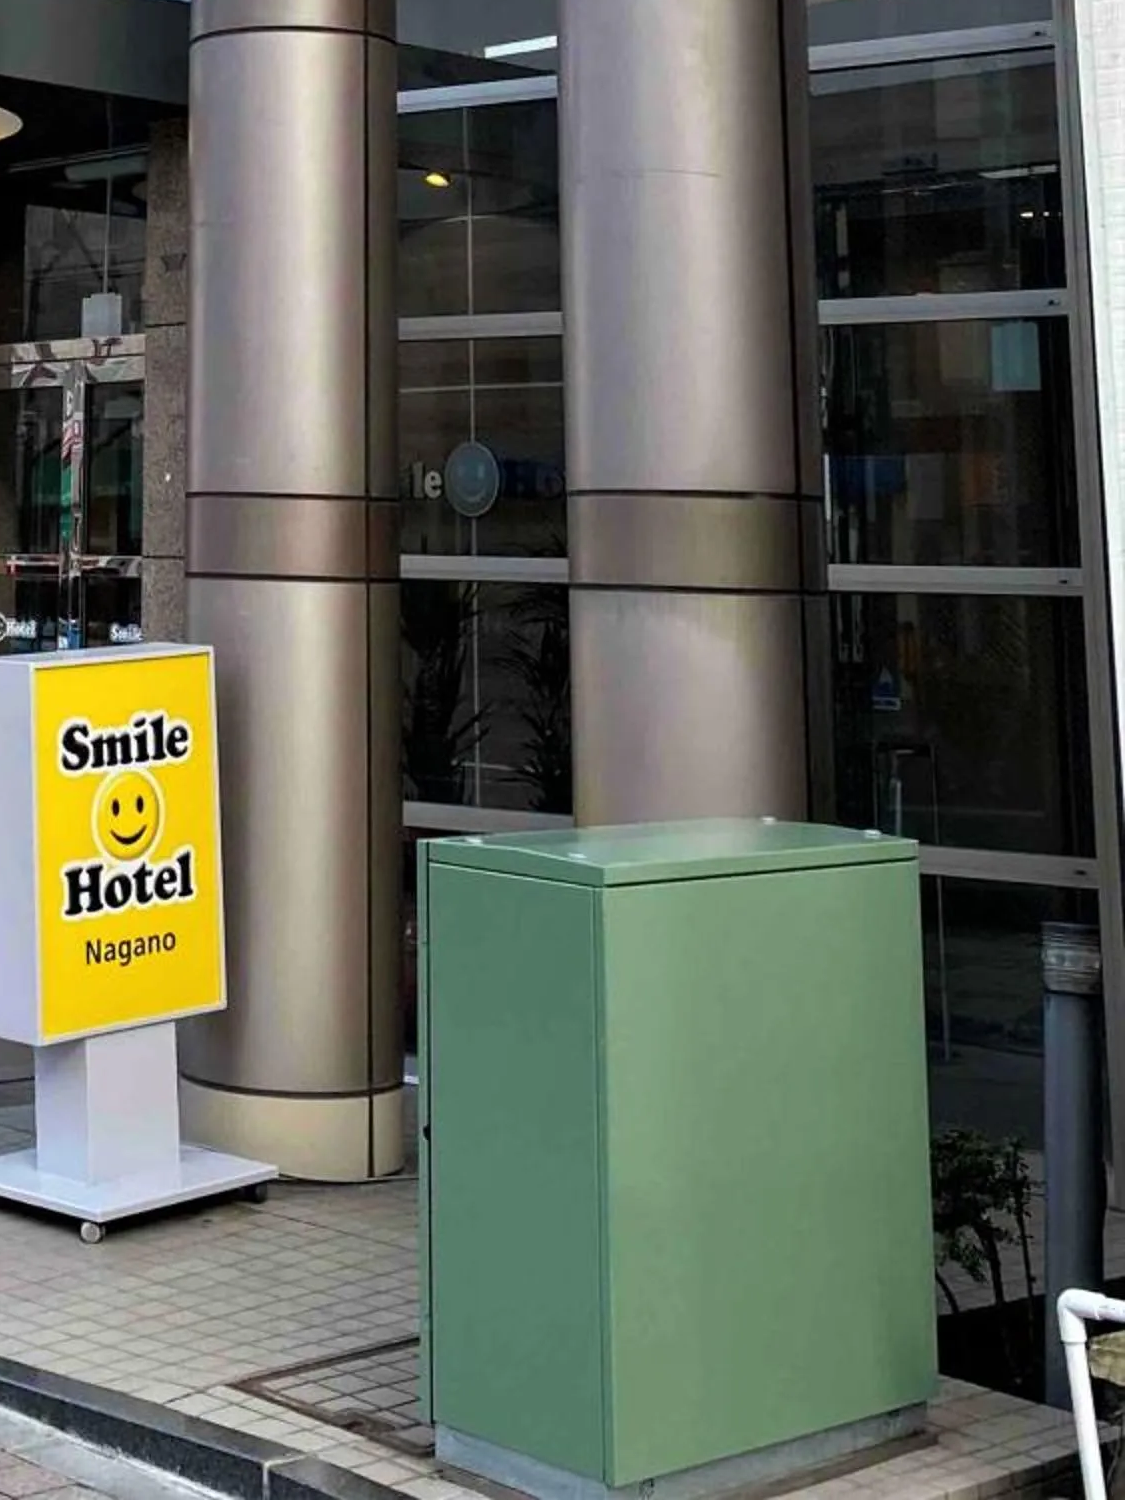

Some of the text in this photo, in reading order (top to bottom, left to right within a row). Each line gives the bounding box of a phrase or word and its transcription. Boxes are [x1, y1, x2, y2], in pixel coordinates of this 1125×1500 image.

[6, 617, 37, 639] Hotel
[61, 713, 191, 772] Smile
[63, 850, 195, 918] Hotel
[85, 930, 176, 967] Nagano
